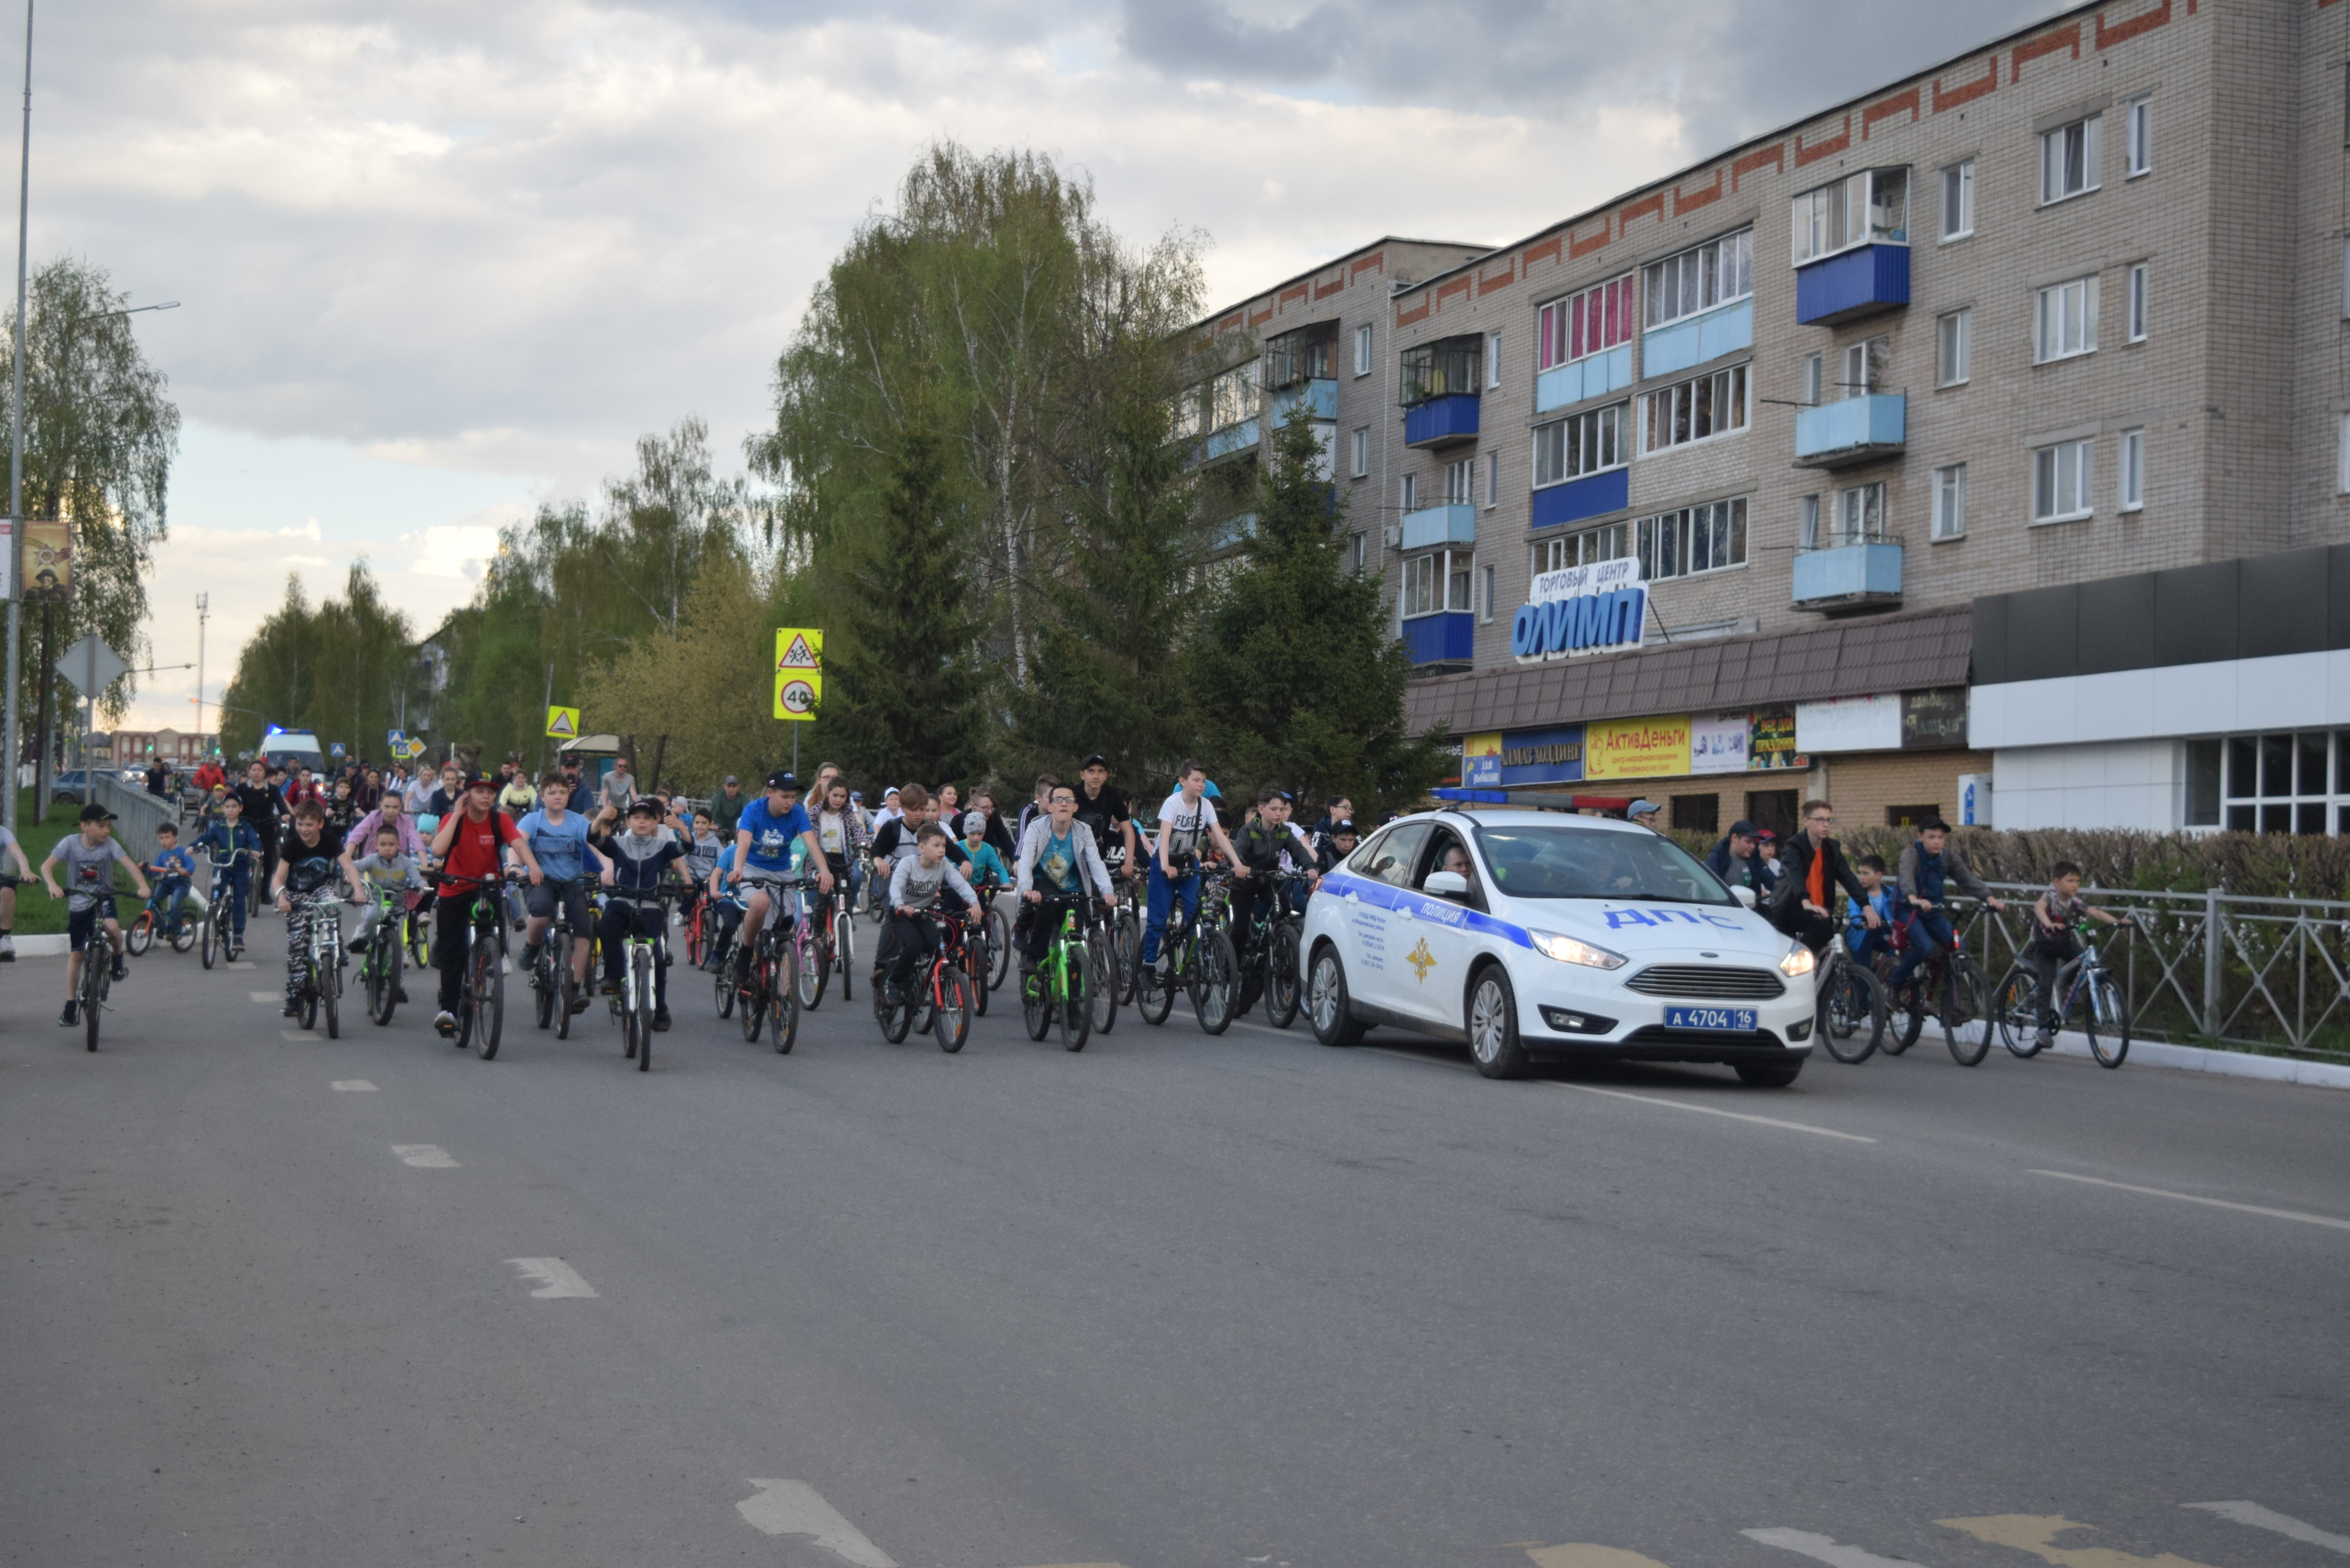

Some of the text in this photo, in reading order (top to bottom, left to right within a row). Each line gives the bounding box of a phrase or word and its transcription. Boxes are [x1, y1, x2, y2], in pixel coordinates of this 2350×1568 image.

[1539, 561, 1629, 593] ТОРГОВЫЙ ЦЕНТР
[1511, 587, 1644, 656] ОЛИМП
[787, 690, 808, 704] 40
[1606, 726, 1685, 751] АктивДеньги
[1755, 737, 1796, 753] ПРАЗДНИК
[1501, 743, 1581, 766] АЛМАЗ ХОЛДИНГ
[1174, 814, 1203, 827] FORCE
[1106, 846, 1126, 860] ILA
[1420, 902, 1461, 924] ПОЛИЦИЯ
[1602, 909, 1744, 929] ДПС
[1688, 1009, 1727, 1027] 4704
[1737, 1010, 1752, 1023] 16
